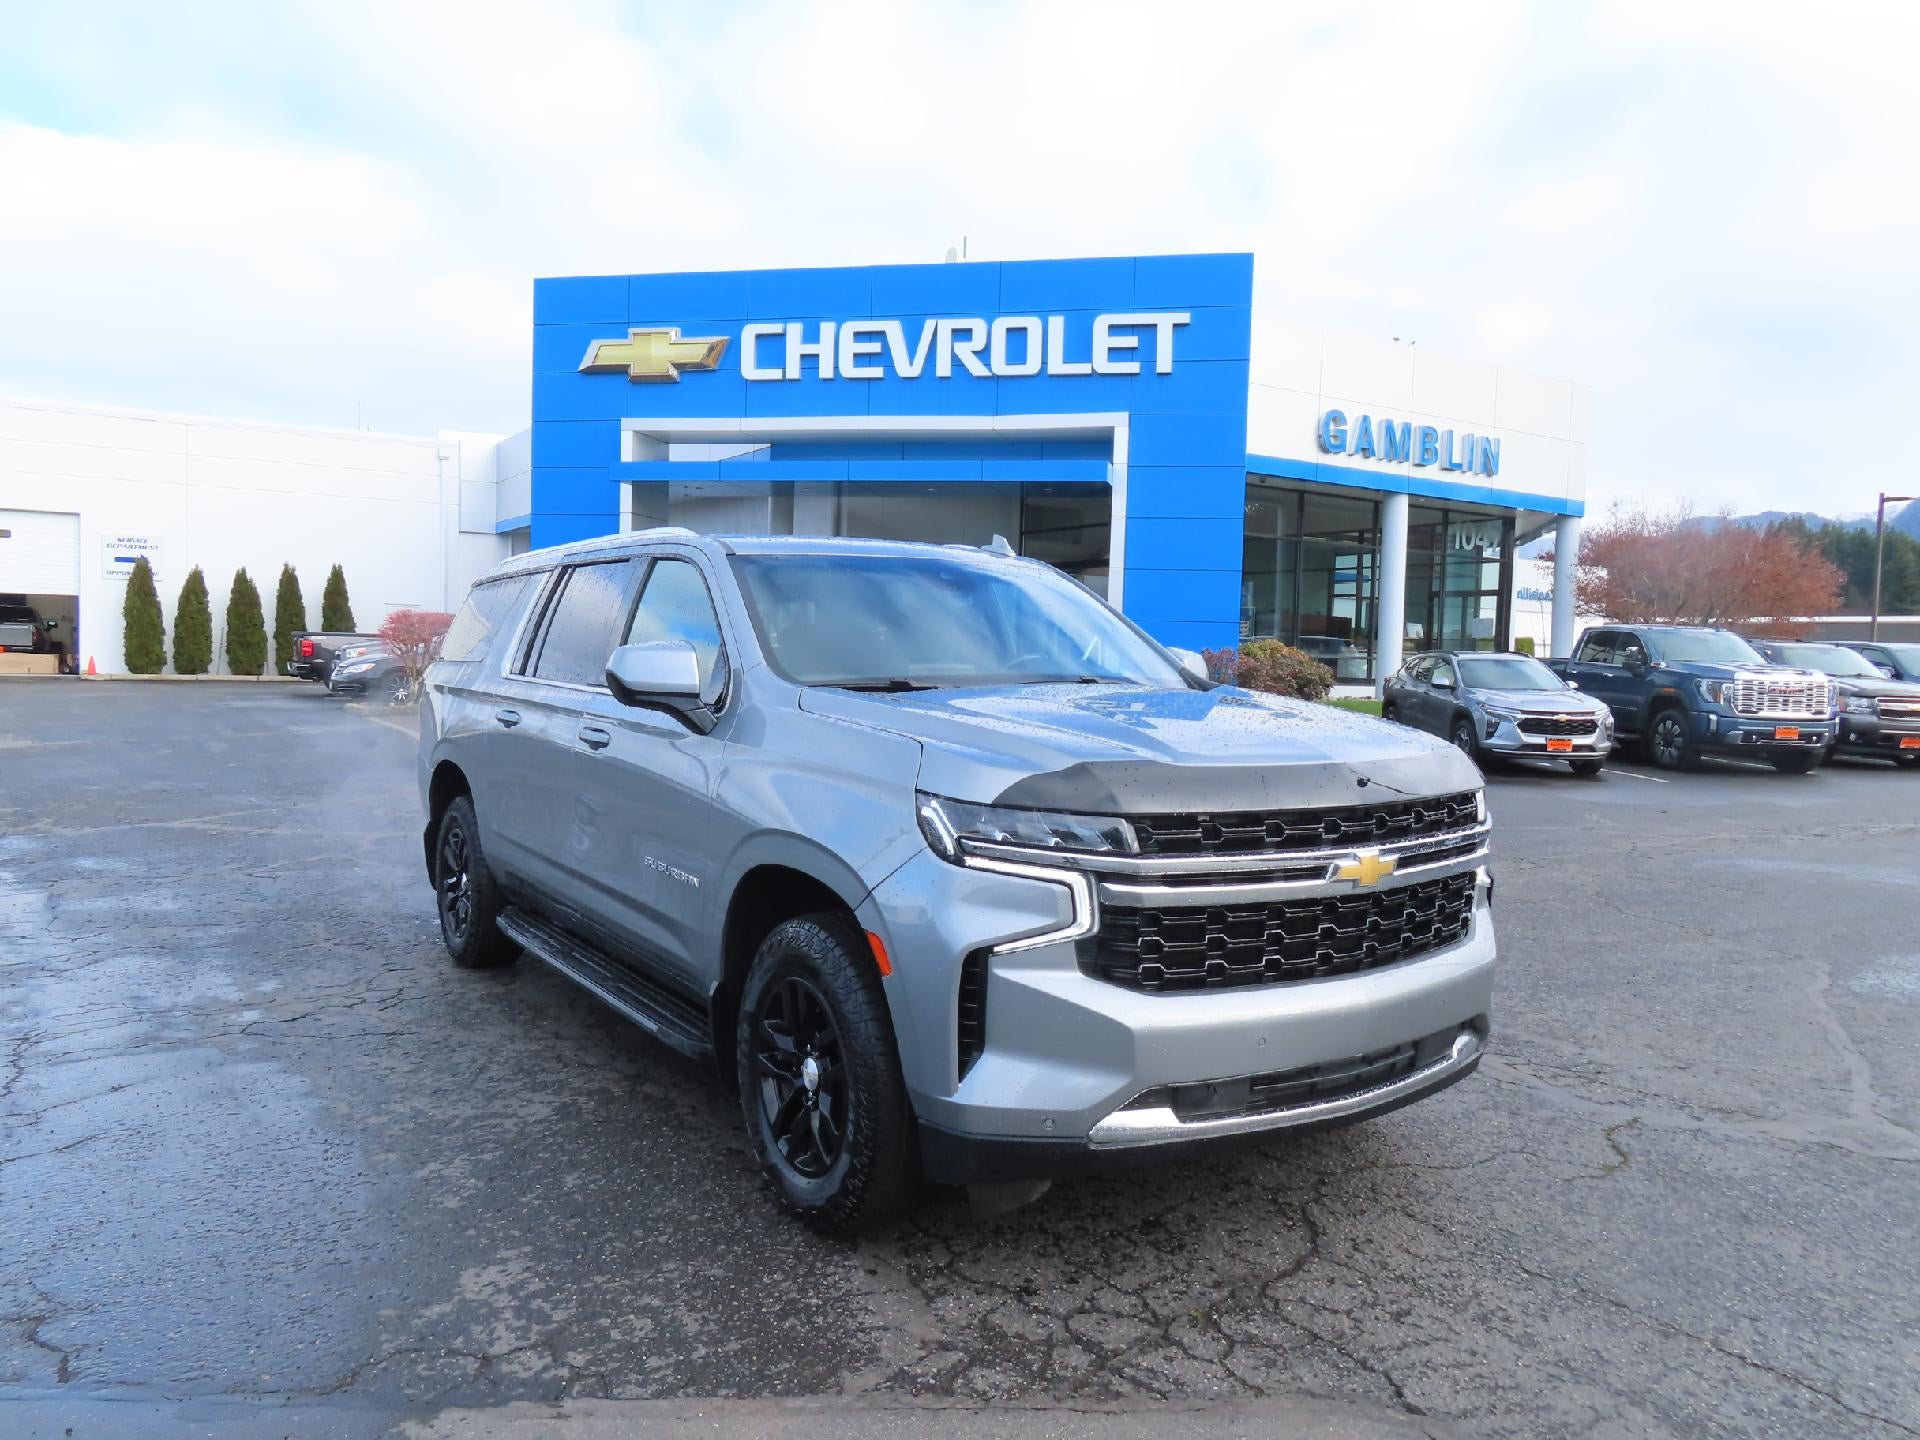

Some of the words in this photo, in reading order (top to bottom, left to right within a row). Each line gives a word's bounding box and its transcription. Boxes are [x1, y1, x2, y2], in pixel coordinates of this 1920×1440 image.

[740, 312, 1191, 380] CHEVROLET
[1317, 408, 1501, 477] GAMBLIN
[644, 856, 700, 888] SUBURBAN
